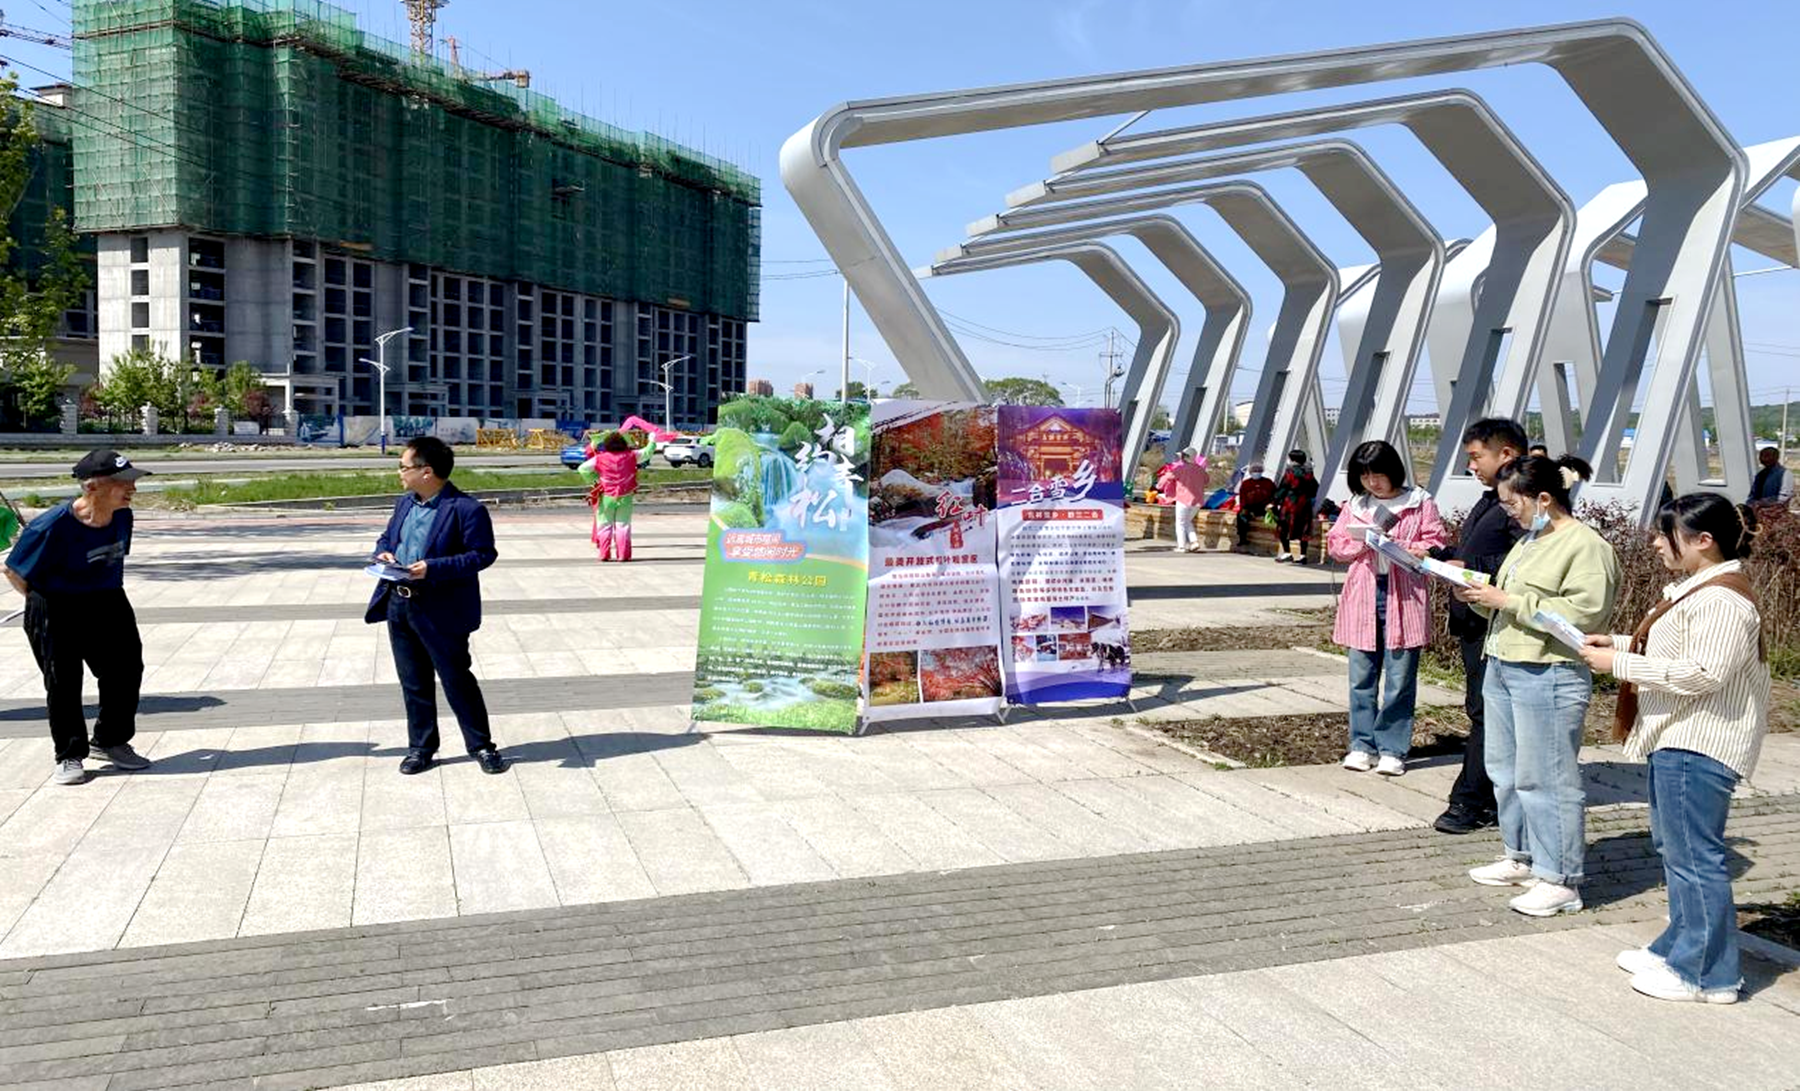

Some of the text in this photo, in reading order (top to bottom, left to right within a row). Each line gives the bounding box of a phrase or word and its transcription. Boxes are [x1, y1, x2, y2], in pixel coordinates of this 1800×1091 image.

[1010, 459, 1097, 505] 二合雪乡
[935, 489, 988, 527] 红叶
[748, 570, 828, 588] 青松森林公园
